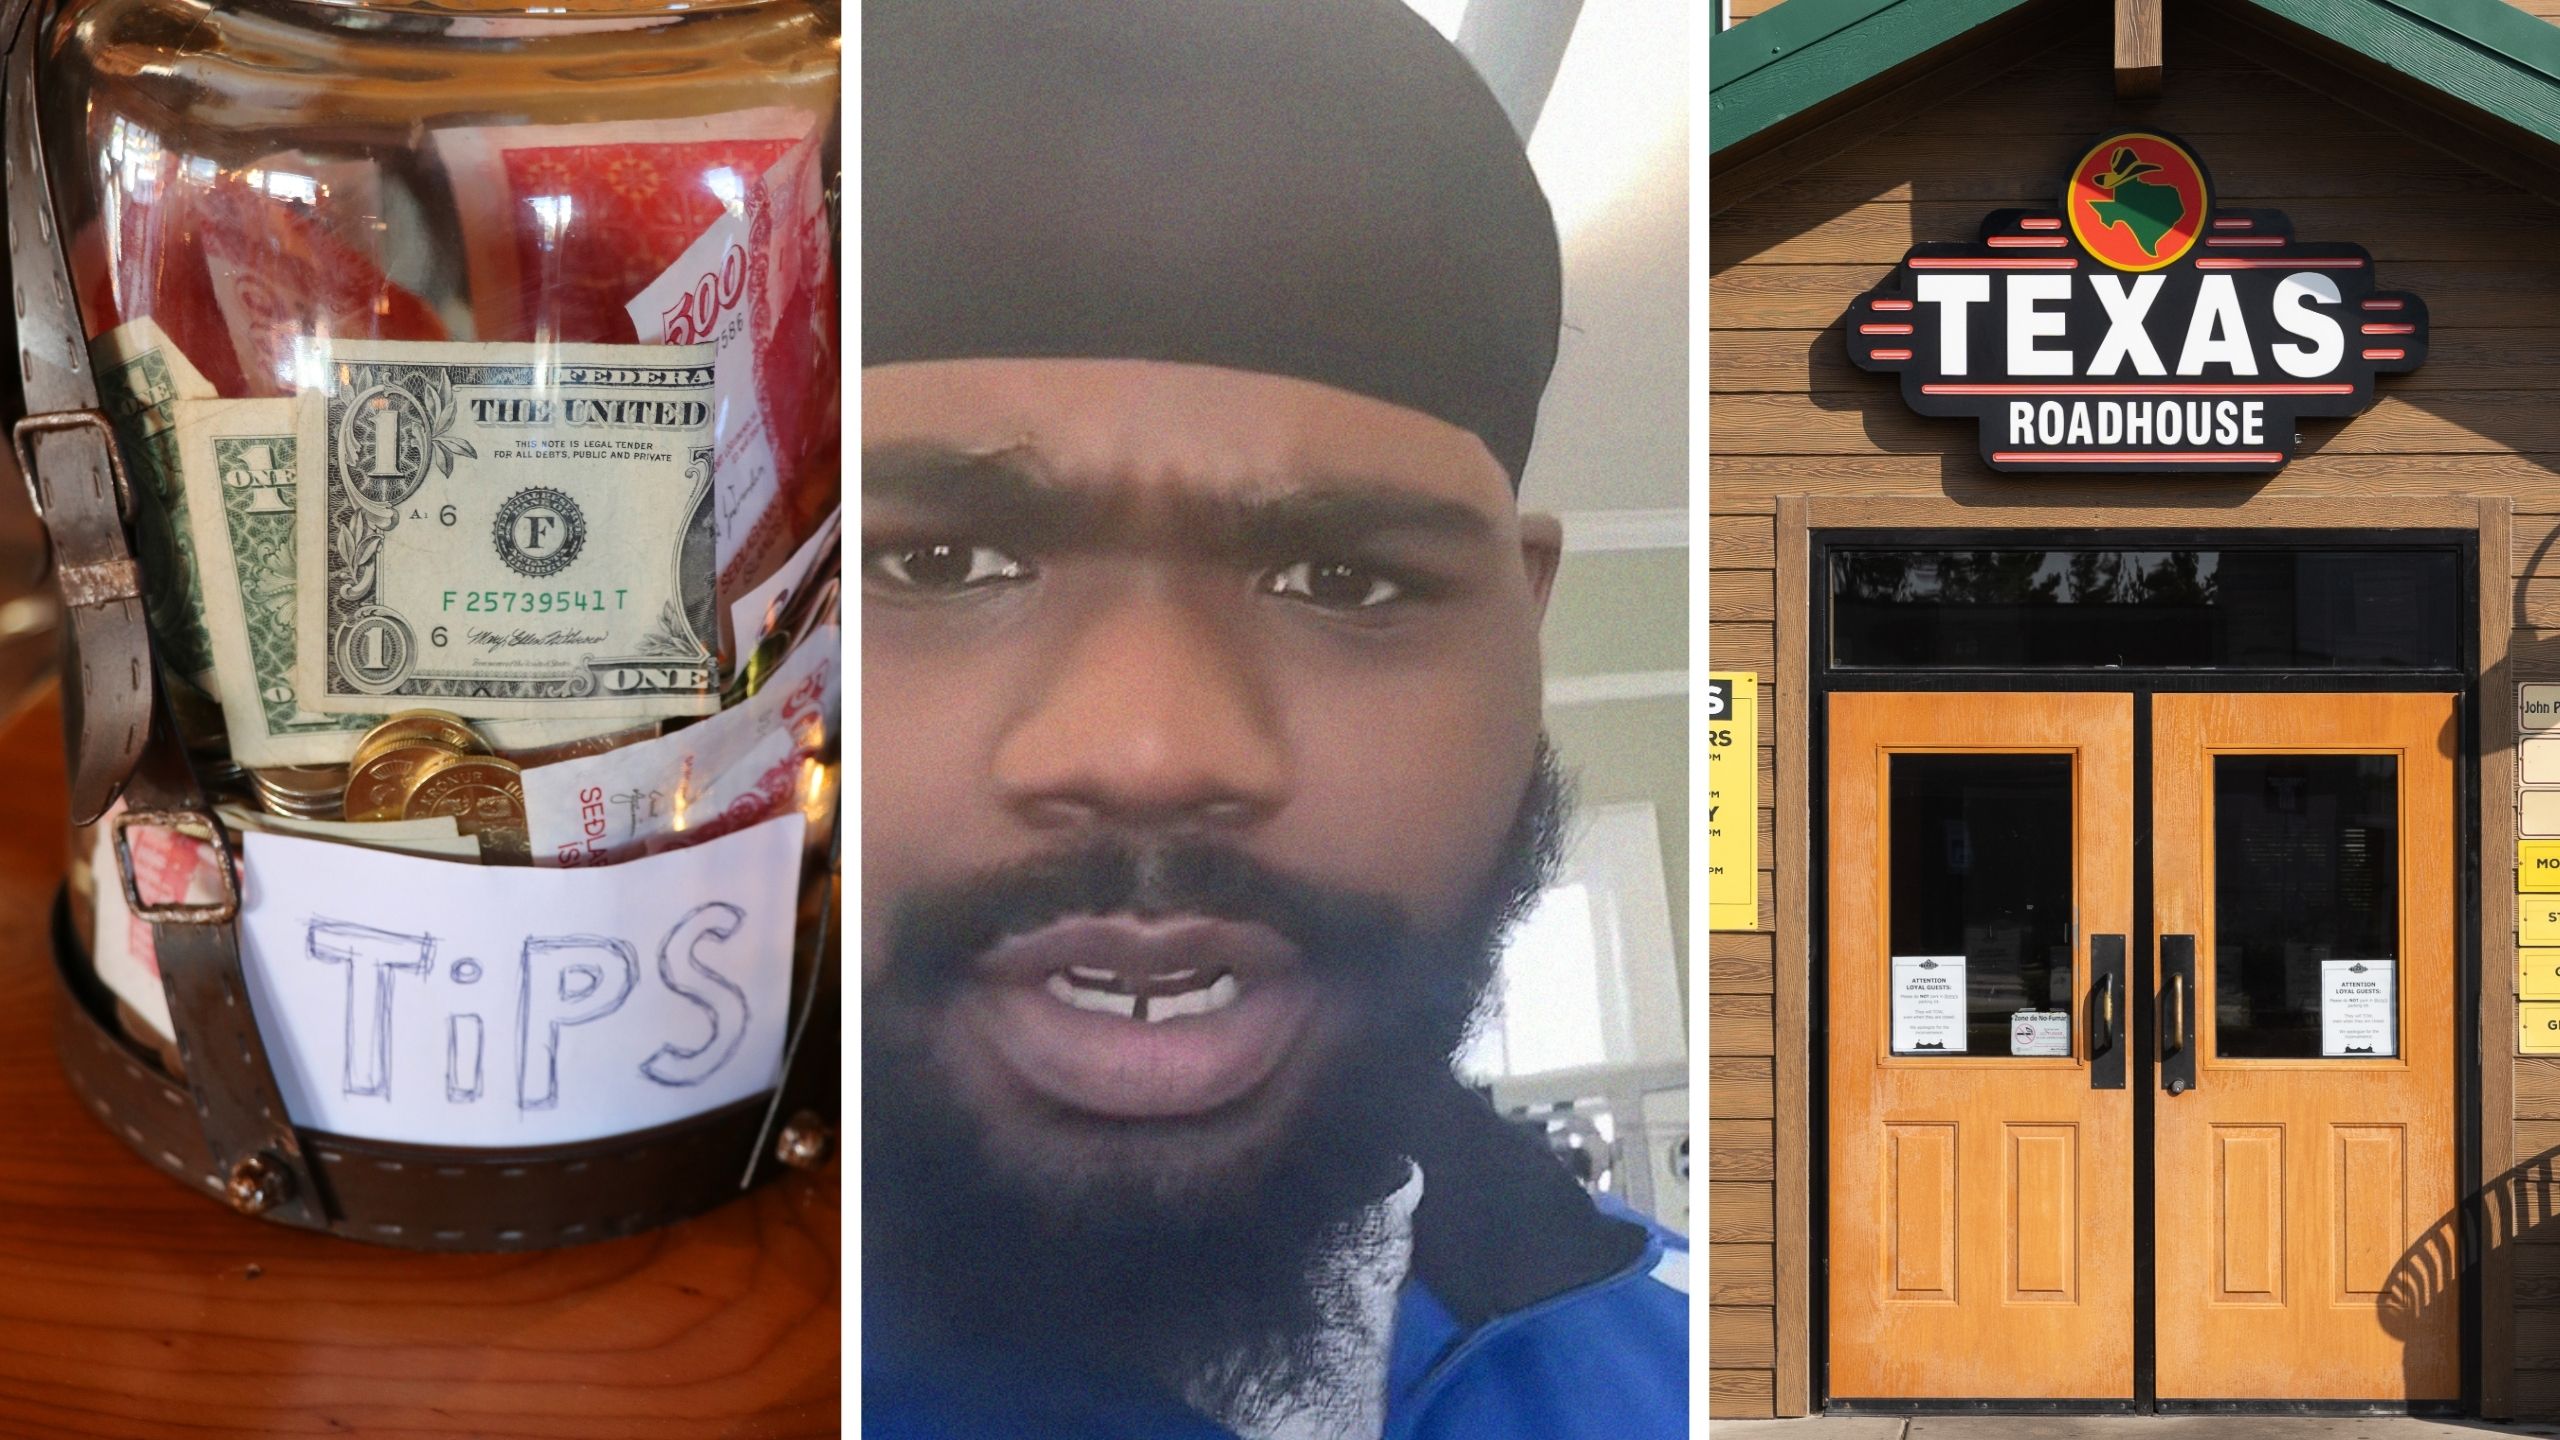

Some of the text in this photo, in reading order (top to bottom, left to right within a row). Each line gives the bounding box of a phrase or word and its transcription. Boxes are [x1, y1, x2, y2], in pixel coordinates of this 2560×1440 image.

[1916, 271, 2345, 378] TEXAS
[471, 398, 709, 430] THE UNITED
[2009, 401, 2264, 446] ROADHOUSE
[367, 409, 406, 478] 1
[494, 450, 673, 462] FOR ALL DEBTS, PUBLIC AND PRIVATE
[515, 440, 653, 450] THIS NOTE IS LEGAL TENDER
[226, 468, 297, 490] ONE
[440, 504, 457, 527] 6
[524, 516, 555, 548] F
[443, 589, 628, 613] F 25739541 T
[363, 626, 448, 671] 1 6
[603, 668, 709, 691] ONE
[2524, 700, 2550, 714] John
[300, 901, 753, 1122] TiPS
